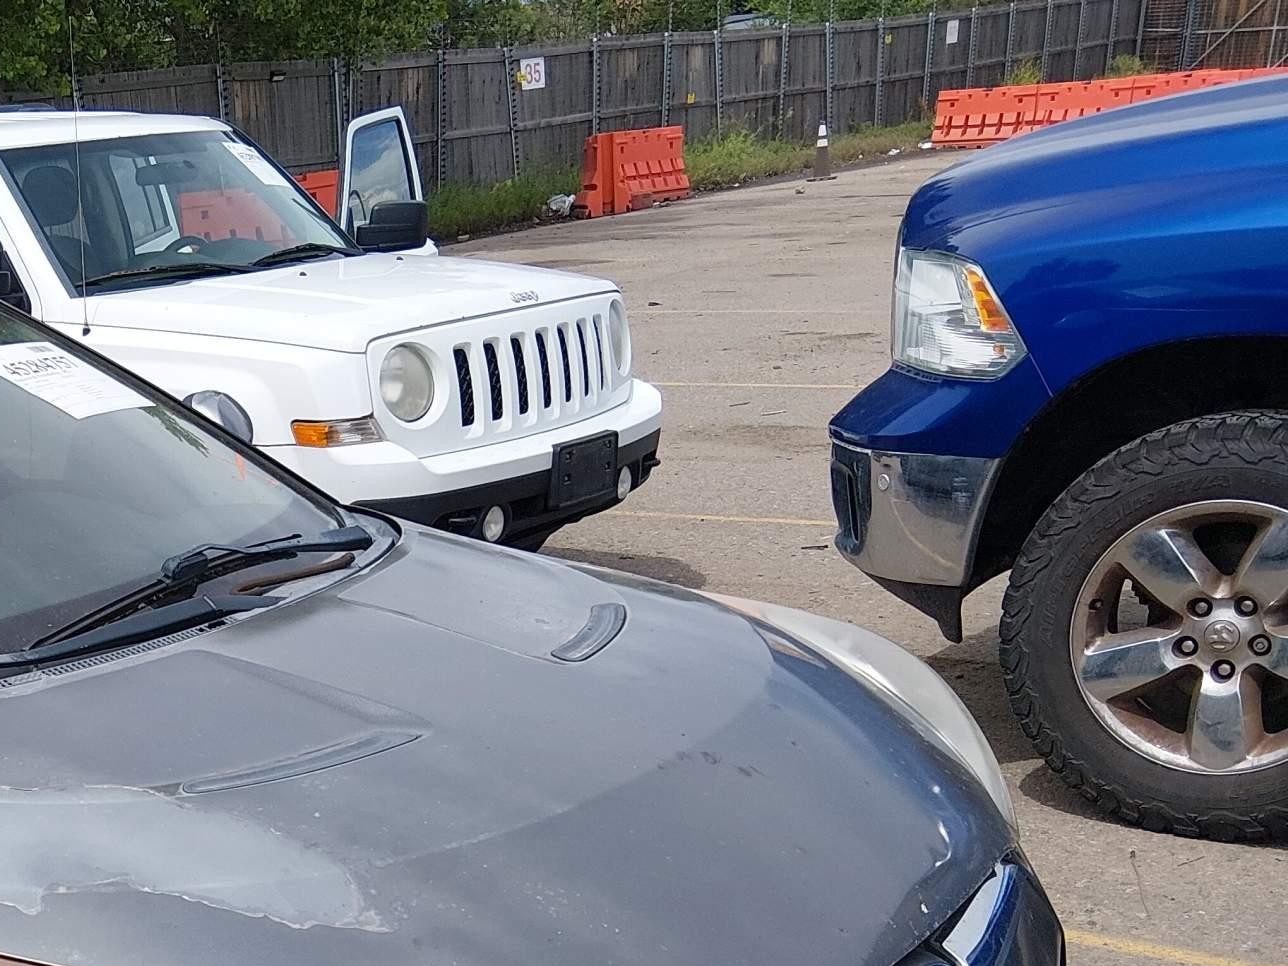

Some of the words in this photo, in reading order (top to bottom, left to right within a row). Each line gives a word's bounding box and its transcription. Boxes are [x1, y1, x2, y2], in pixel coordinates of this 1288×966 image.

[524, 62, 542, 85] 35
[510, 289, 540, 304] Jeep
[2, 355, 79, 377] 45284757
